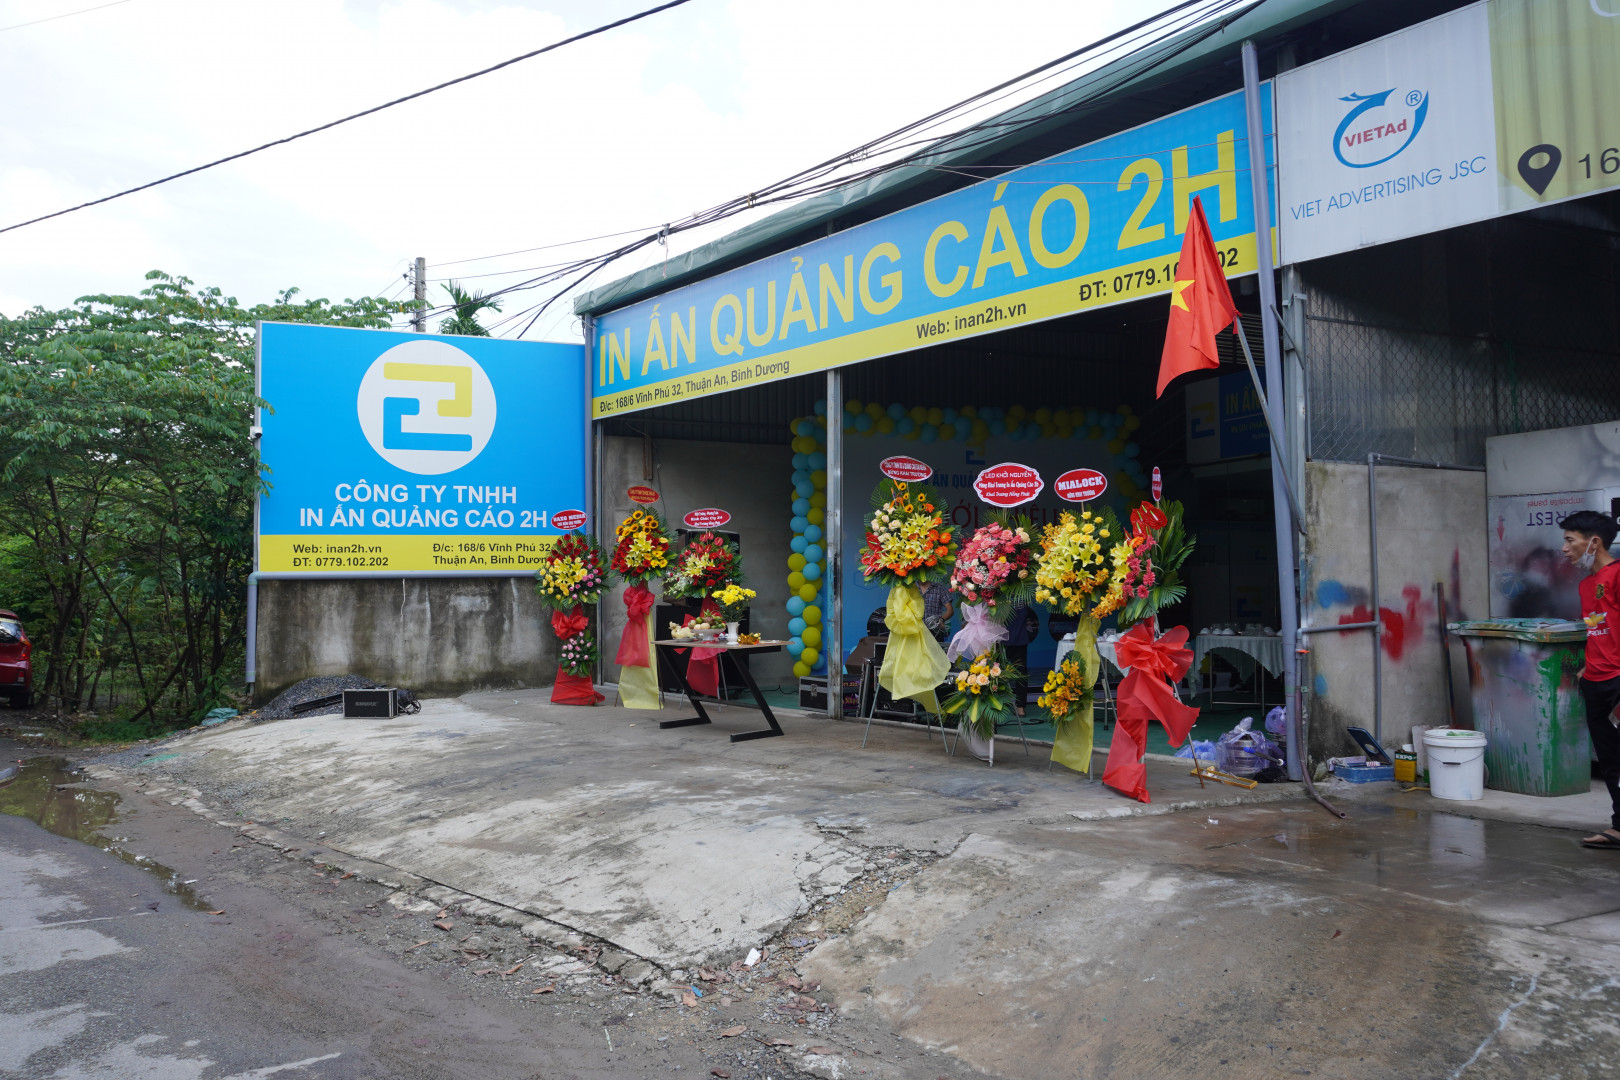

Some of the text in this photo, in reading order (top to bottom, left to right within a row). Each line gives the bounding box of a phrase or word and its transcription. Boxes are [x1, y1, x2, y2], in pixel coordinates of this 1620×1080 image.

[1344, 118, 1408, 148] VIETAd
[1291, 155, 1487, 221] VIET ADVERTISING JSC
[600, 128, 1237, 387] IN ẤN QUẢNG CÁO 2H
[1079, 280, 1107, 301] ĐT:
[916, 302, 1027, 339] Web: inan2h.vn
[600, 360, 790, 413] Đ/c: 168/6 Vĩnh Phú 32, Thuận An, Bình Dương
[334, 478, 517, 504] CÔNG TY TNHH
[1057, 476, 1103, 490] MIALOCK
[300, 504, 547, 529] IN ẤN QUẢNG CÁO 2H
[293, 544, 382, 553] Web: inan2h.vn
[433, 543, 454, 552] Đ/c:
[458, 543, 486, 552] 168/6
[488, 543, 513, 552] Vĩnh
[515, 543, 536, 552] Phú
[292, 557, 389, 567] ĐT: 0779.102.202
[433, 555, 547, 566] Thuận An, Bình Dươn
